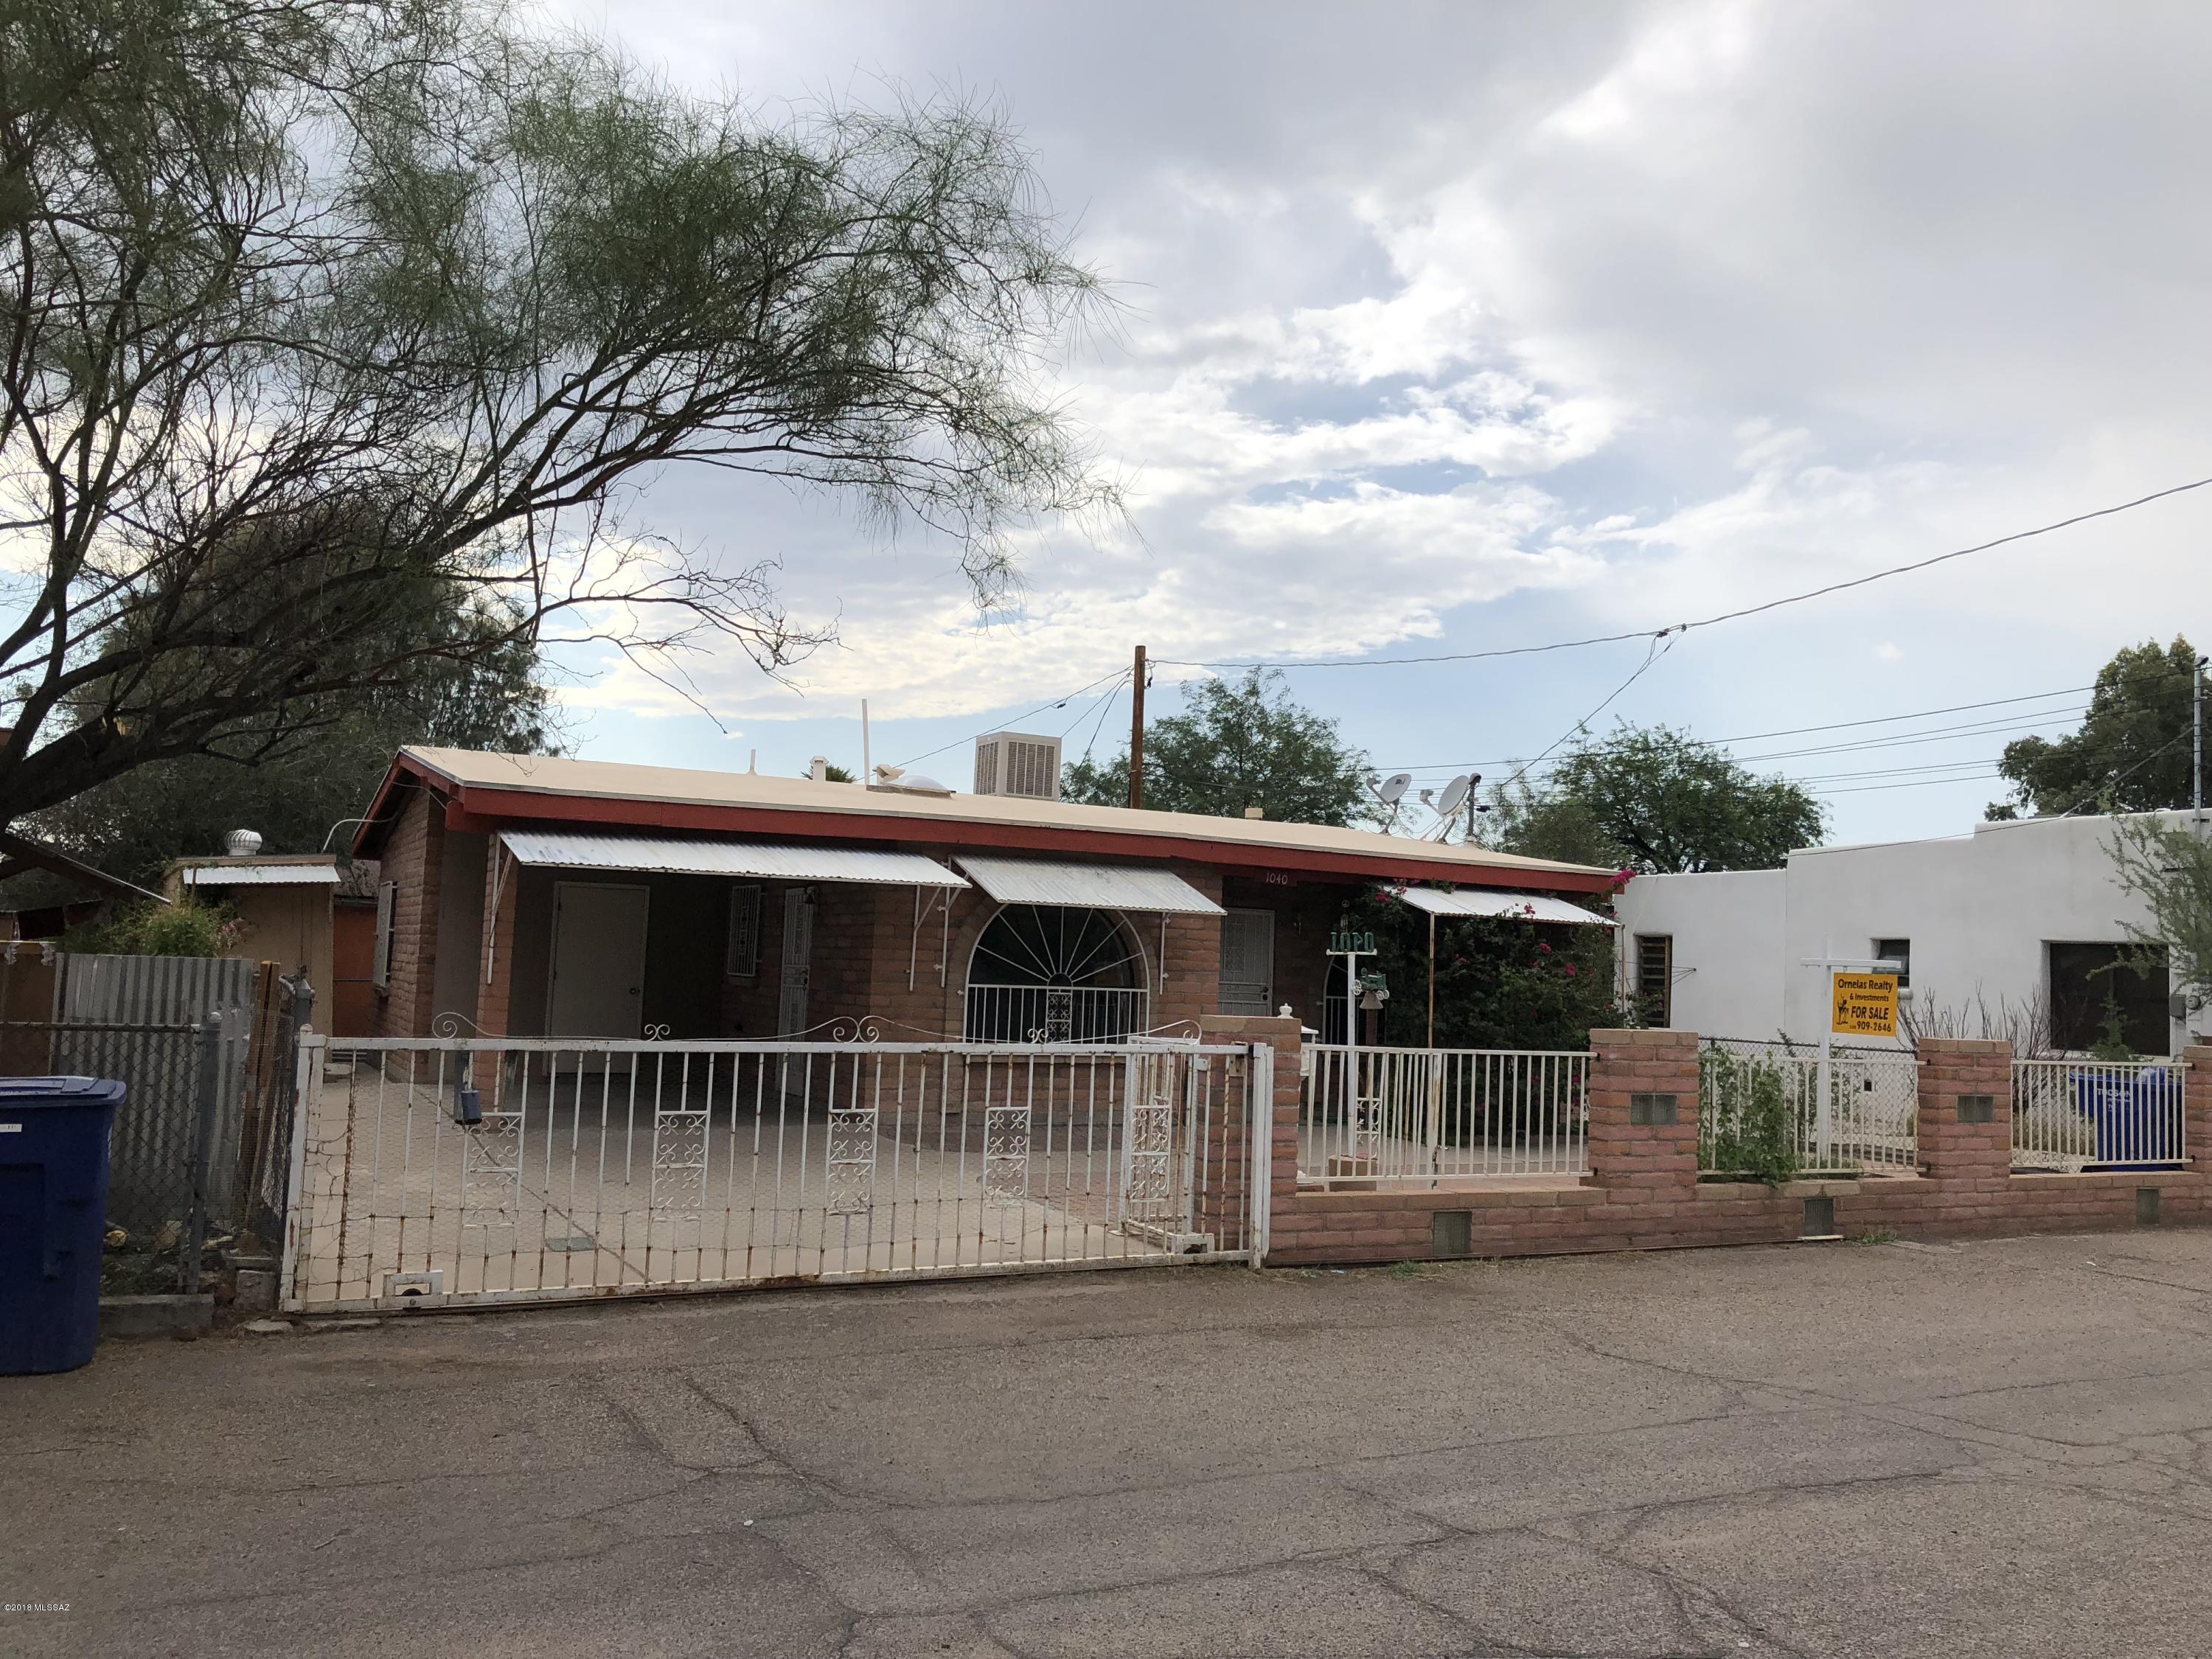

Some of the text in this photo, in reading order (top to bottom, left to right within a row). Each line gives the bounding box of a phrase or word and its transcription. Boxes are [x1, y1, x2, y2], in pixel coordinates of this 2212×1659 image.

[1266, 872, 1287, 884] 1040
[1838, 978, 1893, 993] Ornelas Realty
[1854, 993, 1889, 1002] Investments
[1851, 1006, 1889, 1020] FOR SALE
[1857, 1020, 1892, 1032] 909-2646
